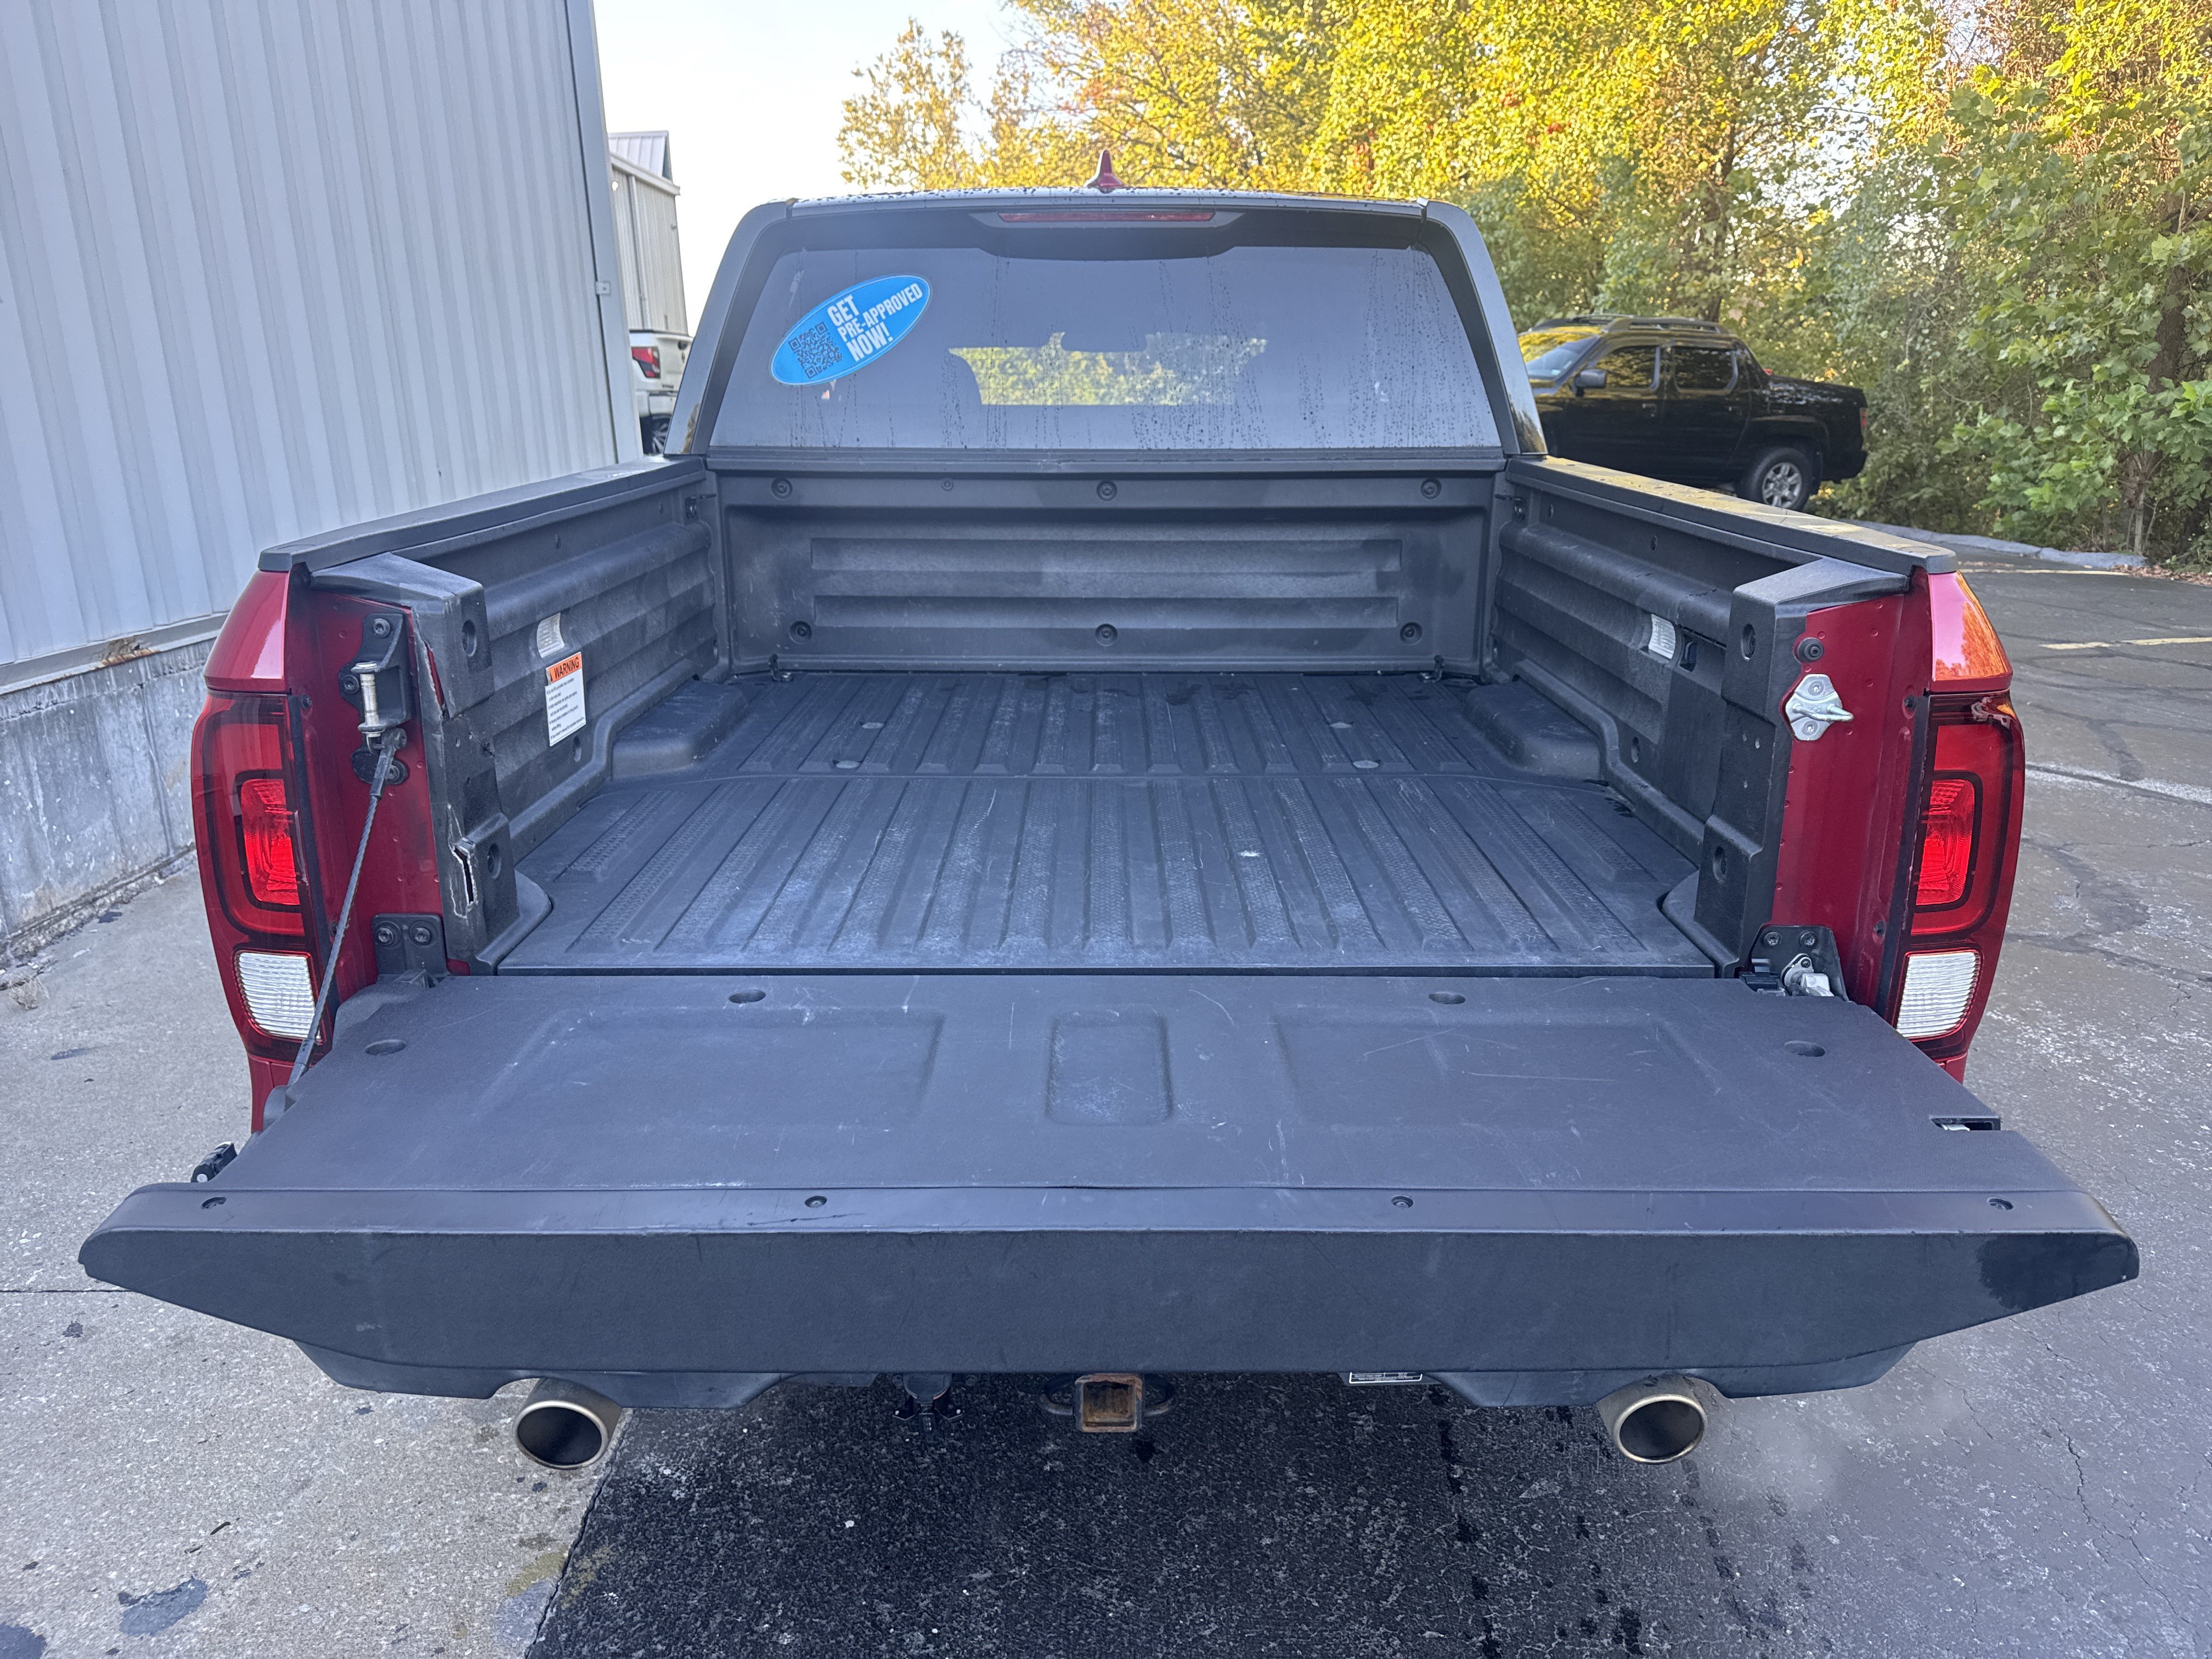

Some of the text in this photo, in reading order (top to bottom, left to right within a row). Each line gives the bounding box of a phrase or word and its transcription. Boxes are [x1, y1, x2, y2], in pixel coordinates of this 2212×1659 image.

[827, 295, 860, 327] GET
[837, 283, 923, 342] PRE-APPROVED
[846, 321, 894, 362] NOW!
[554, 657, 579, 679] WARNING
